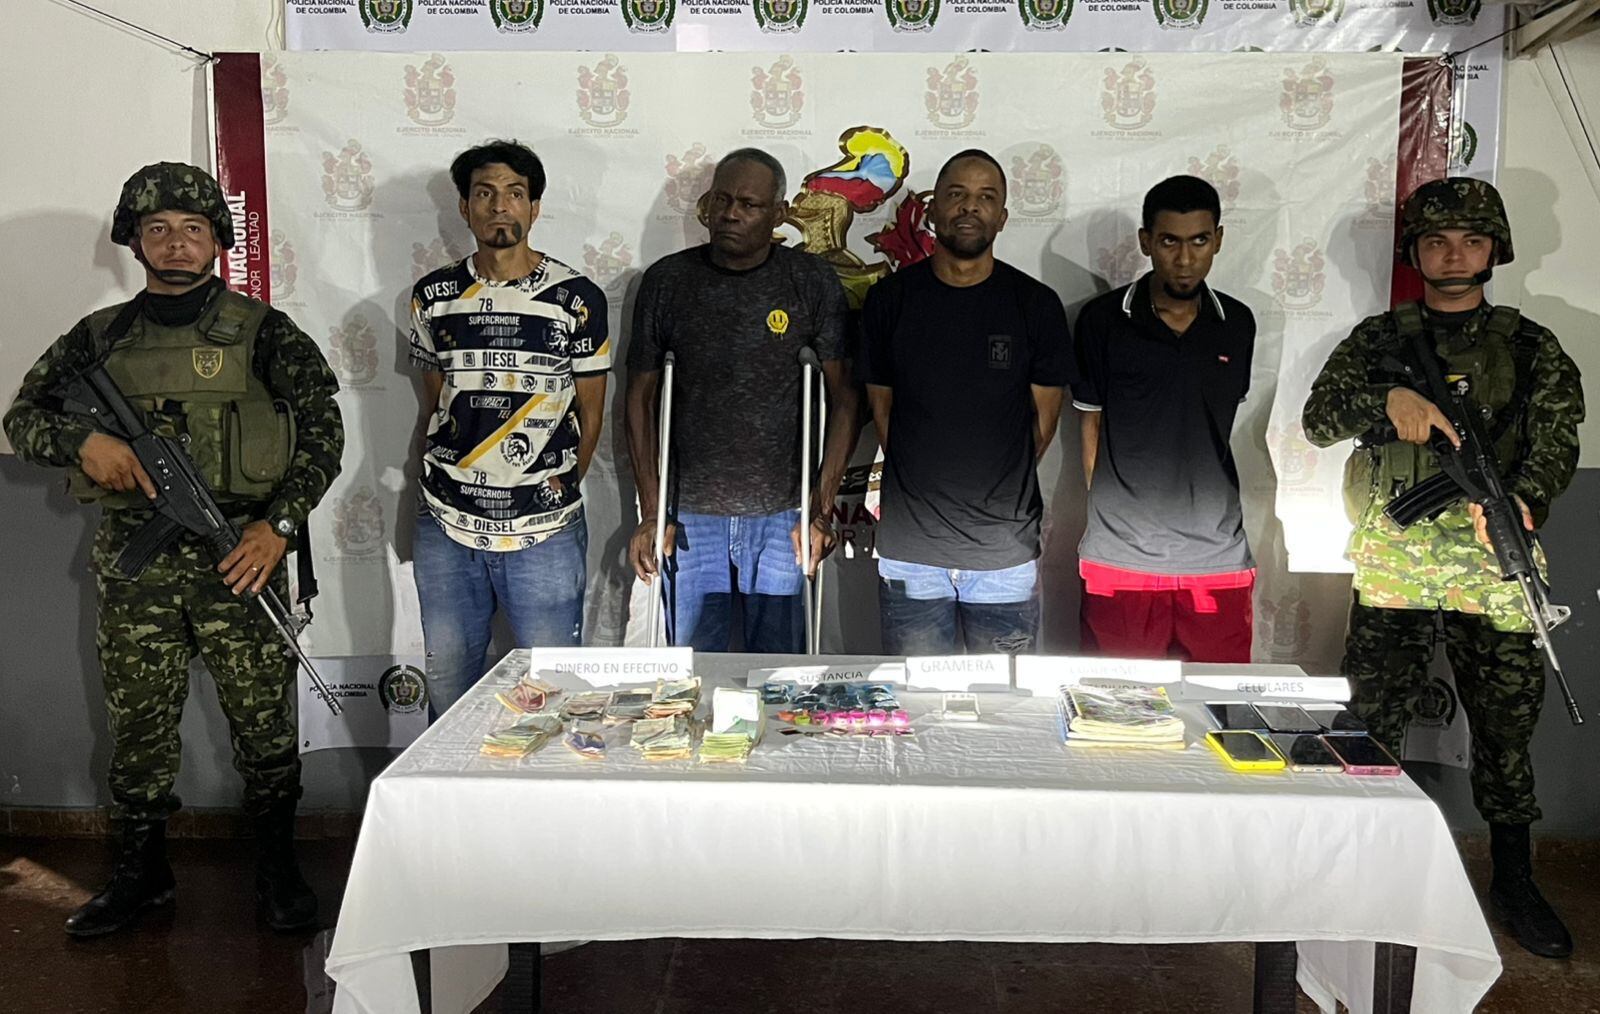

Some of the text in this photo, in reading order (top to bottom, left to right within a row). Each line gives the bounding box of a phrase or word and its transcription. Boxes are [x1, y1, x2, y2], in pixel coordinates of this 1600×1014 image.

[558, 7, 610, 15] DE COLOMBIA
[690, 7, 742, 15] DE COLOMBIA
[1088, 4, 1140, 12] DE COLOMBIA
[227, 190, 248, 284] NACIONAL
[248, 211, 261, 261] LEALTAD
[424, 280, 461, 300] DIESEL
[478, 298, 494, 311] 78
[468, 316, 520, 326] SUPERCRHOME
[482, 351, 520, 368] DIESEL
[473, 471, 487, 485] 78
[460, 485, 513, 499] SUPERCRHOME
[474, 519, 517, 533] DIESEL
[555, 662, 688, 673] DINERO EN EFECTIVO
[920, 659, 995, 673] GRAMERA
[800, 671, 863, 684] SUSTANCIA
[1237, 682, 1304, 693] CELULARES
